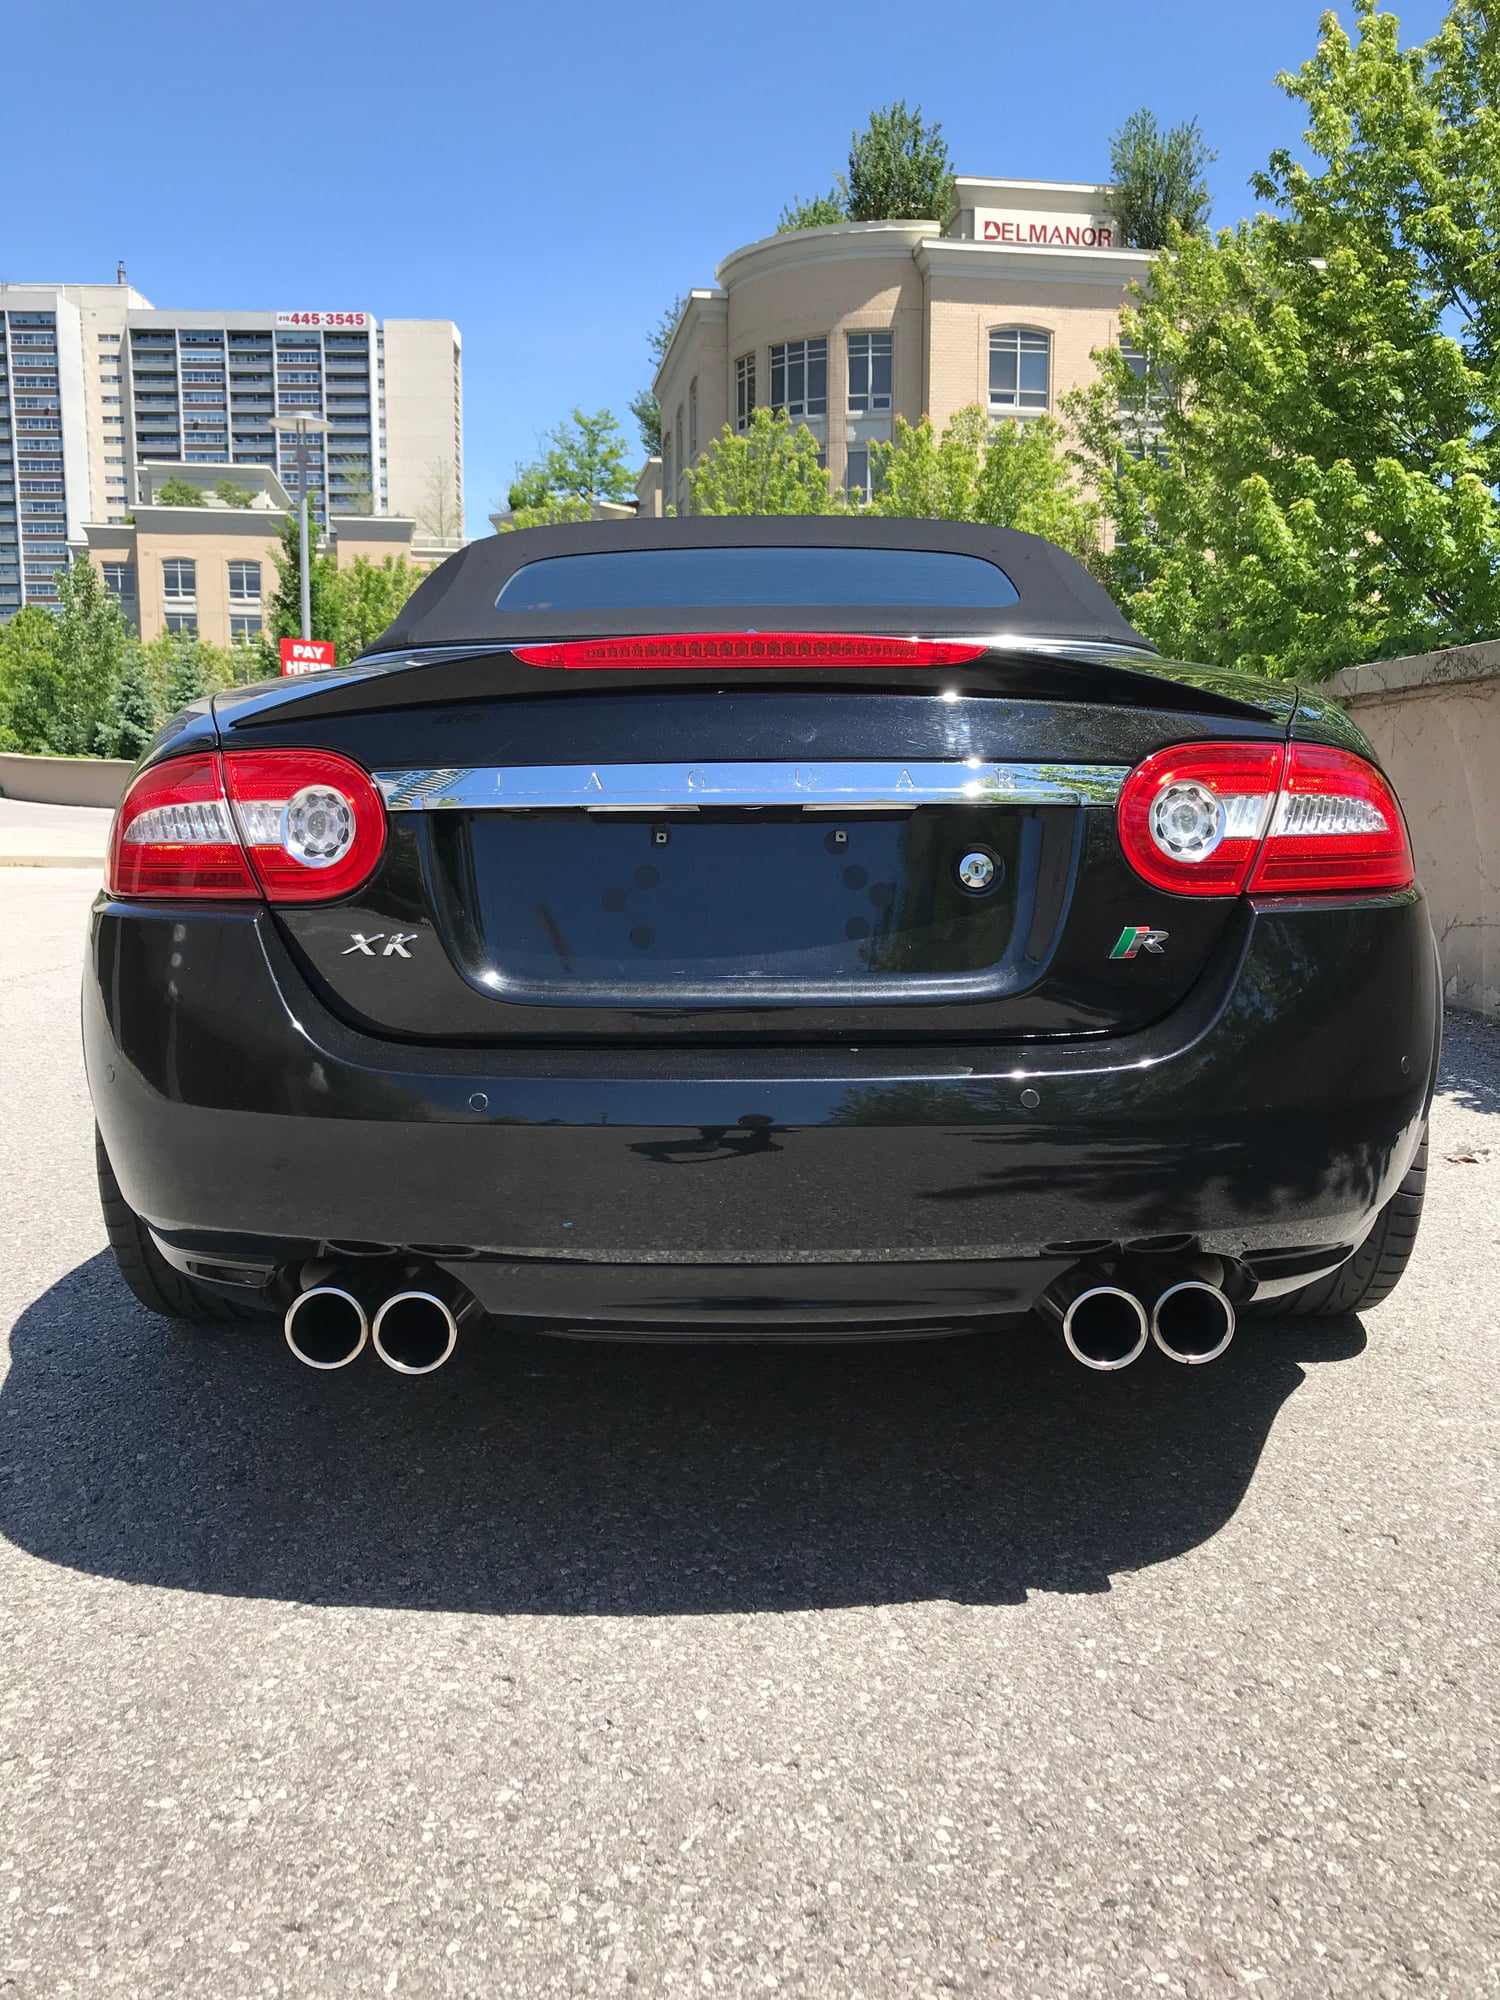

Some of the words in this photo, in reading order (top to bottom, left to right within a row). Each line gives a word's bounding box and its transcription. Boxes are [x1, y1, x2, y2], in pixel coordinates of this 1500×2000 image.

[984, 220, 1112, 247] DELMANOR
[291, 312, 364, 325] 445-3545
[292, 644, 325, 660] PAY
[341, 933, 418, 958] XK
